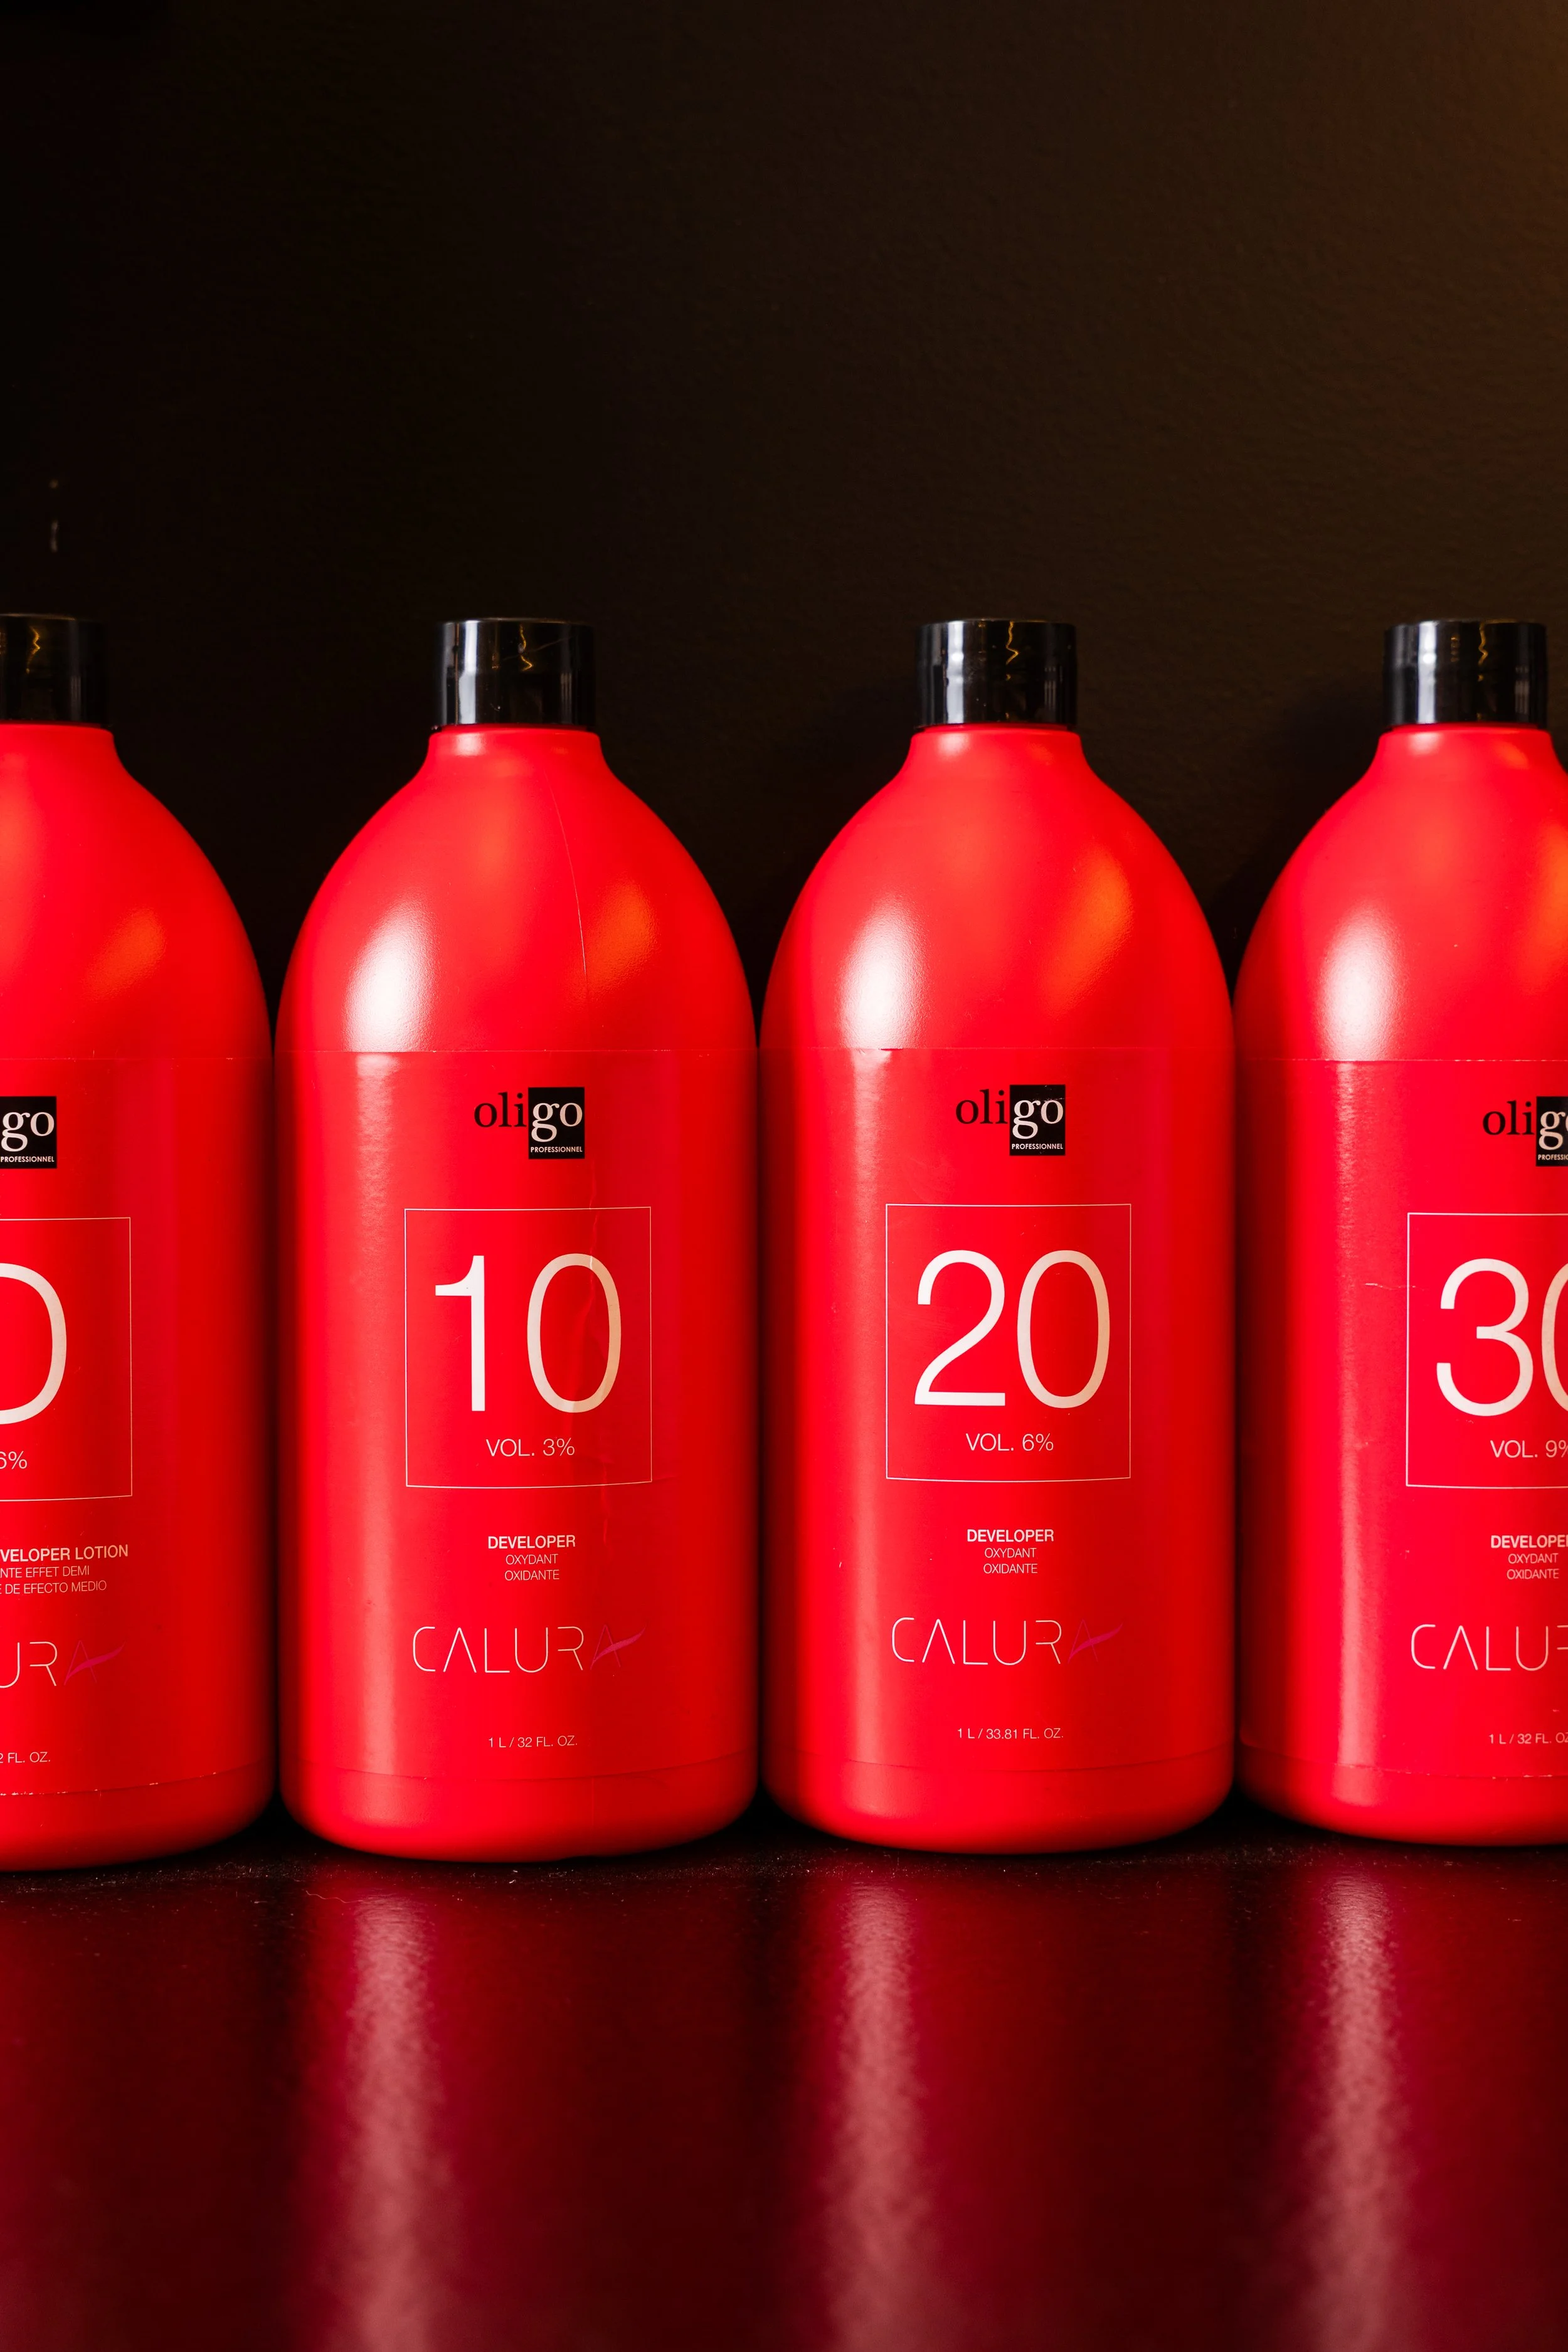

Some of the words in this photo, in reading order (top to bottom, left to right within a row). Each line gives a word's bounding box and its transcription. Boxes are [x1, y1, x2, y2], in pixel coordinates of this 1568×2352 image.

[474, 1092, 583, 1143] oligo
[956, 1089, 1064, 1140] oligo
[1482, 1100, 1568, 1150] olig
[435, 1253, 622, 1413] 10
[914, 1249, 1110, 1409] 20
[1436, 1258, 1568, 1417] 3
[485, 1438, 535, 1457] VOL.
[543, 1437, 575, 1456] 3%
[965, 1433, 1014, 1452] VOL.
[1022, 1433, 1054, 1452] 6%
[1490, 1439, 1538, 1458] VOL.
[488, 1534, 576, 1549] DEVELOPER
[967, 1528, 1054, 1543] DEVELOPER
[1491, 1534, 1568, 1549] DEVELOPE
[75, 1544, 129, 1560] LOTION
[506, 1553, 558, 1565] OXYDANT
[984, 1547, 1037, 1559] OXYDANT
[1508, 1552, 1559, 1564] OXYDANT
[26, 1566, 60, 1578] EFFET
[63, 1565, 90, 1577] DEMI
[504, 1569, 559, 1581] OXIDANTE
[983, 1562, 1038, 1574] OXIDANTE
[1507, 1568, 1559, 1580] OXIDANTE
[5, 1583, 21, 1594] DE
[24, 1581, 68, 1594] EFECTO
[72, 1580, 107, 1592] MEDIO
[412, 1624, 647, 1673] CALURA
[891, 1616, 1124, 1666] CALURA
[957, 1728, 963, 1739] 1
[968, 1728, 975, 1739] L
[986, 1728, 1019, 1740] 33.81
[1024, 1728, 1041, 1739] FL.
[1044, 1727, 1064, 1739] OZ.
[1488, 1734, 1494, 1744] 1
[1499, 1733, 1507, 1744] L
[1517, 1733, 1532, 1744] 32
[1535, 1733, 1552, 1744] FL.
[488, 1737, 494, 1748] 1
[499, 1737, 507, 1748] L
[517, 1737, 532, 1748] 32
[536, 1736, 554, 1747] FL.
[557, 1735, 578, 1747] OZ.
[8, 1752, 26, 1764] FL.
[29, 1751, 51, 1763] OZ.
